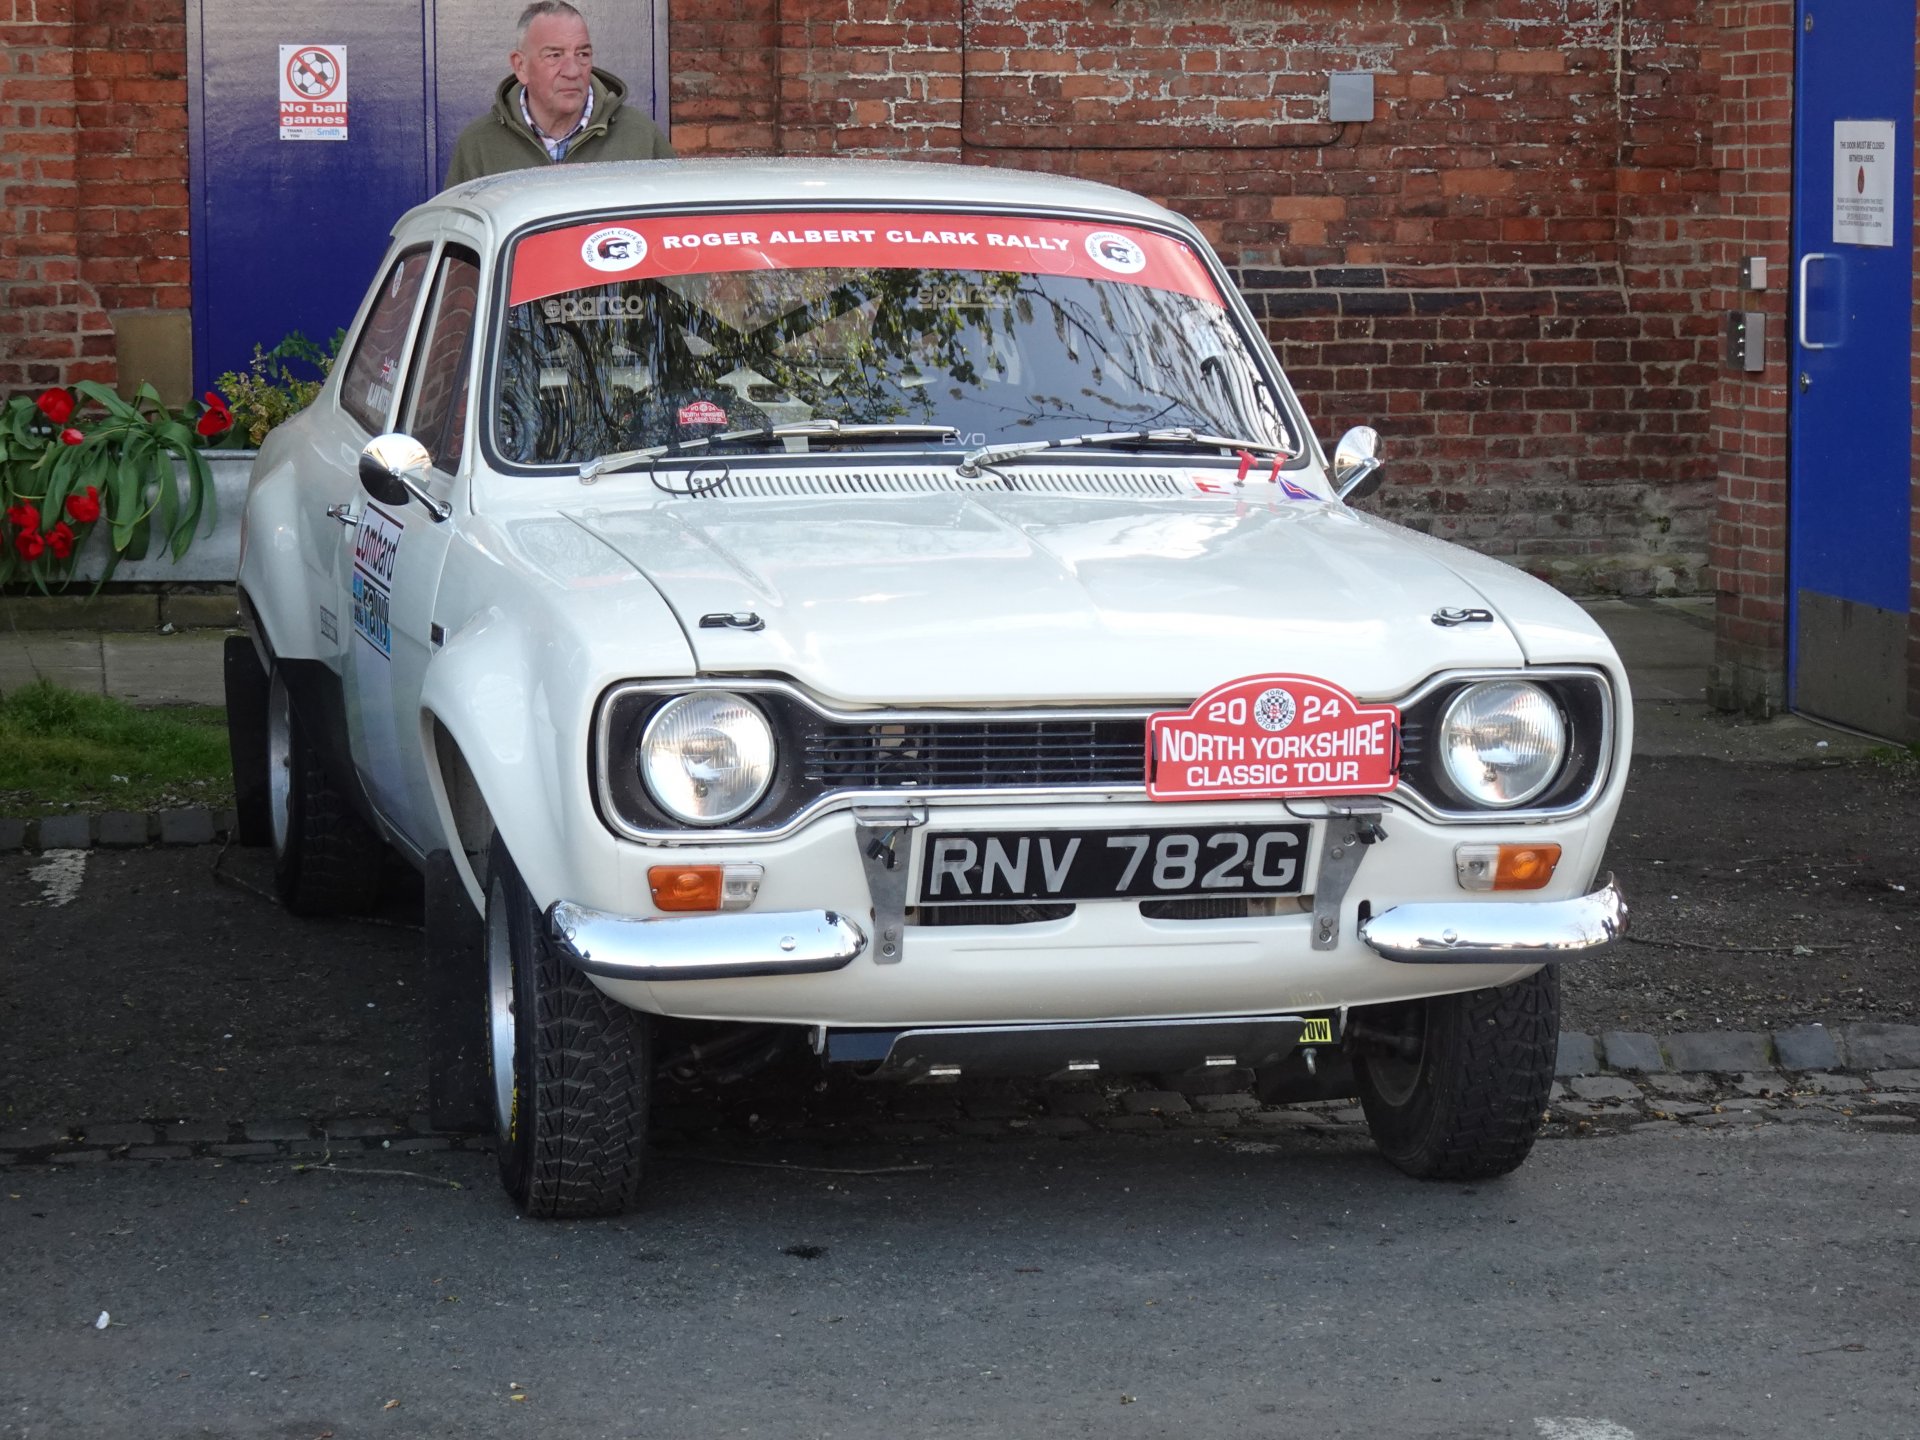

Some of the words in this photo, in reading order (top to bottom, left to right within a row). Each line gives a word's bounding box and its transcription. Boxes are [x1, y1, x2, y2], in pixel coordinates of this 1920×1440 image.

[281, 103, 306, 112] No
[313, 103, 346, 112] ball
[282, 116, 345, 125] games
[586, 244, 595, 262] Roger
[591, 230, 615, 243] Albert
[618, 230, 638, 240] Clark
[634, 240, 643, 255] Rally
[663, 231, 760, 249] ROGER
[770, 229, 876, 244] ALBERT
[887, 230, 980, 246] CLARK
[987, 233, 1070, 251] RALLY
[544, 295, 643, 323] sparco
[917, 284, 1012, 310] sparco
[942, 433, 985, 446] EVO
[355, 509, 401, 582] Lombard
[1265, 689, 1285, 697] YORK
[1208, 698, 1247, 726] 20
[1303, 696, 1341, 724] 24
[1255, 710, 1276, 730] MOTOR
[1279, 710, 1295, 728] CLUB
[1162, 726, 1245, 762] NORTH
[1251, 719, 1385, 760] YORKSHIRE
[1186, 763, 1288, 787] CLASSIC
[1294, 761, 1358, 784] TOUR
[928, 837, 1082, 896] RNV
[1106, 831, 1300, 892] 782G
